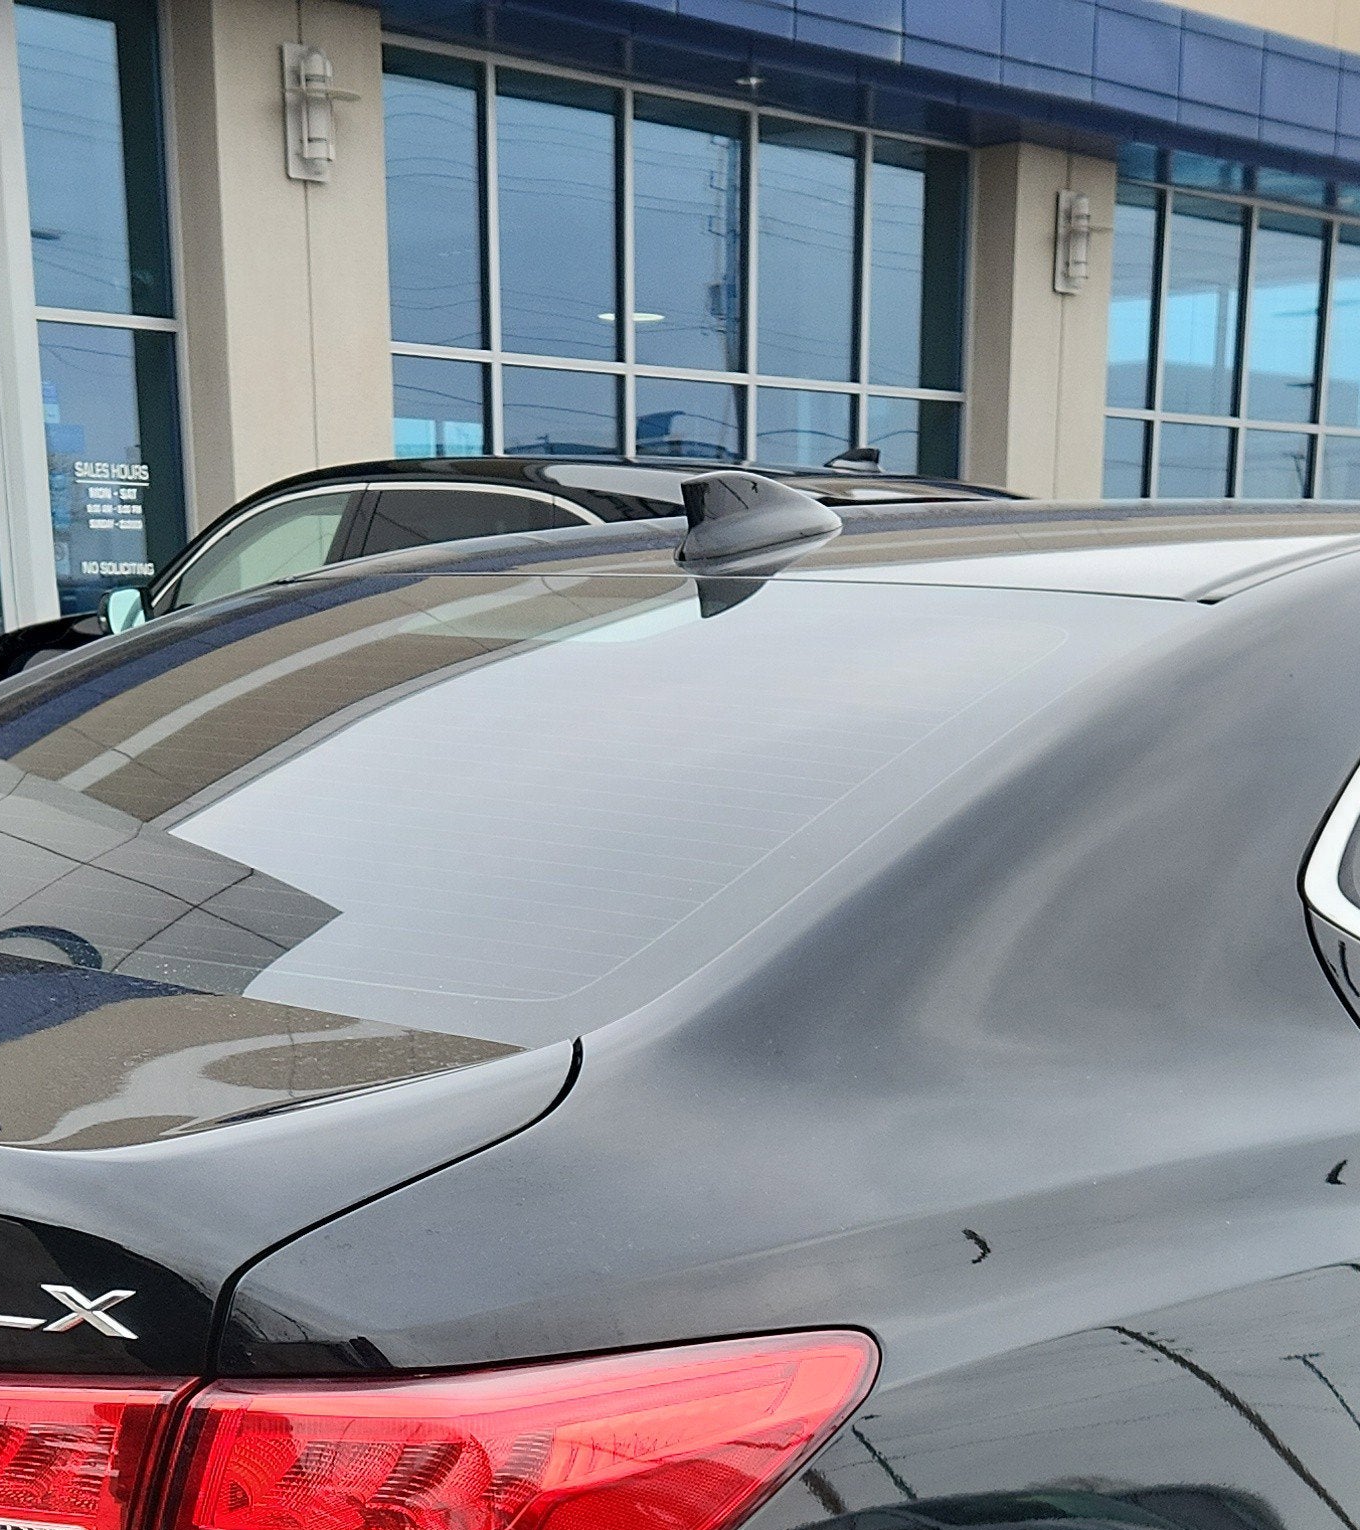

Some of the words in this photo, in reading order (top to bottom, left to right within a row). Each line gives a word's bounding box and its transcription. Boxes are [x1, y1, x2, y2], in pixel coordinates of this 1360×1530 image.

[74, 461, 109, 478] SALES
[111, 463, 149, 480] HOURS
[81, 561, 99, 574] NO
[100, 561, 155, 576] SOLICITING
